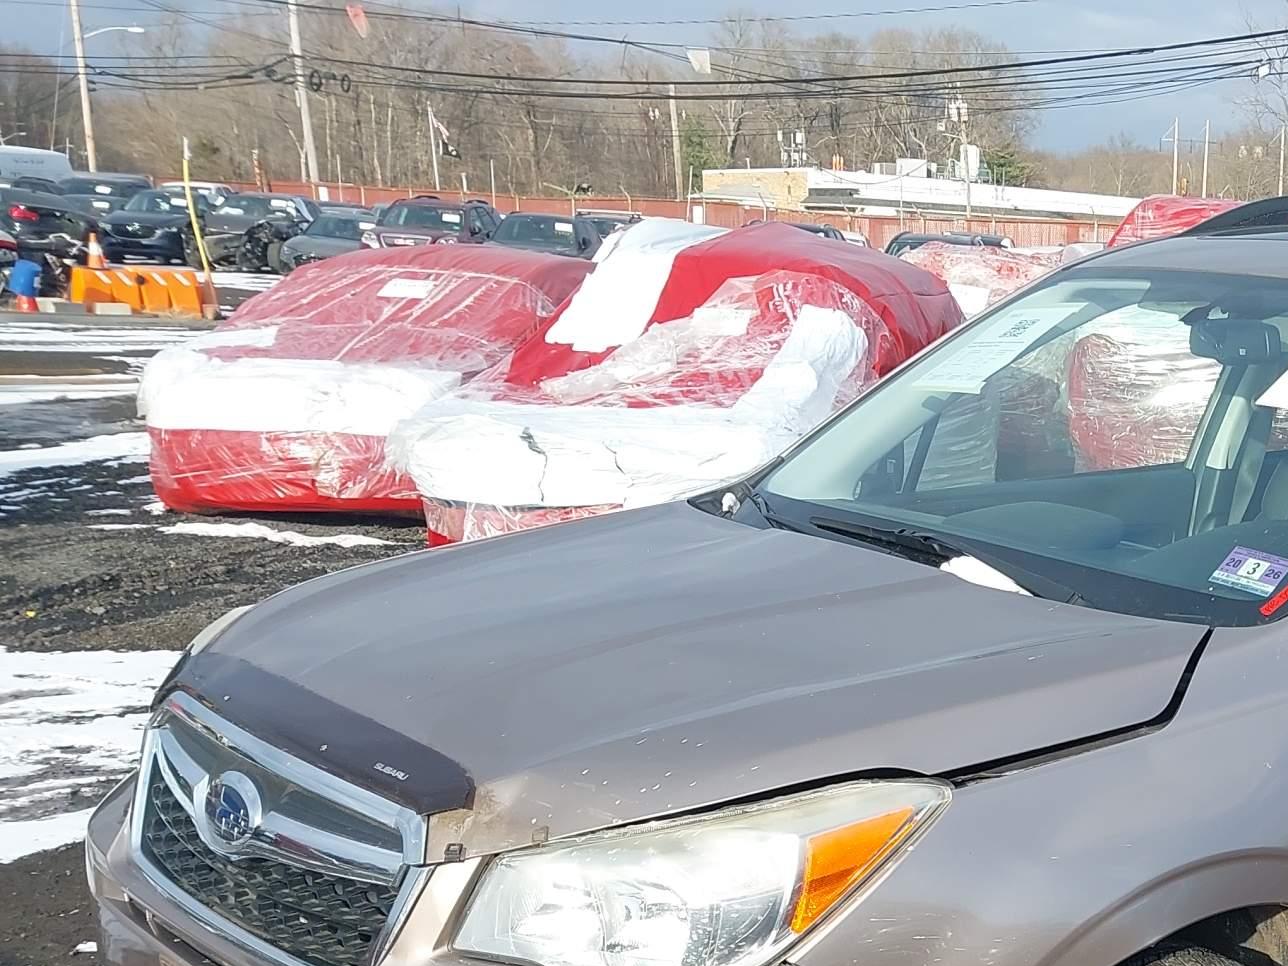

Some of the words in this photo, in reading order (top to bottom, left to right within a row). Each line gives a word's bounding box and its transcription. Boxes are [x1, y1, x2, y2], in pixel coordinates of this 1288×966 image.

[1225, 557, 1242, 569] 20
[1246, 562, 1261, 576] 3
[1264, 568, 1282, 580] 26
[372, 762, 410, 780] SUBARU
